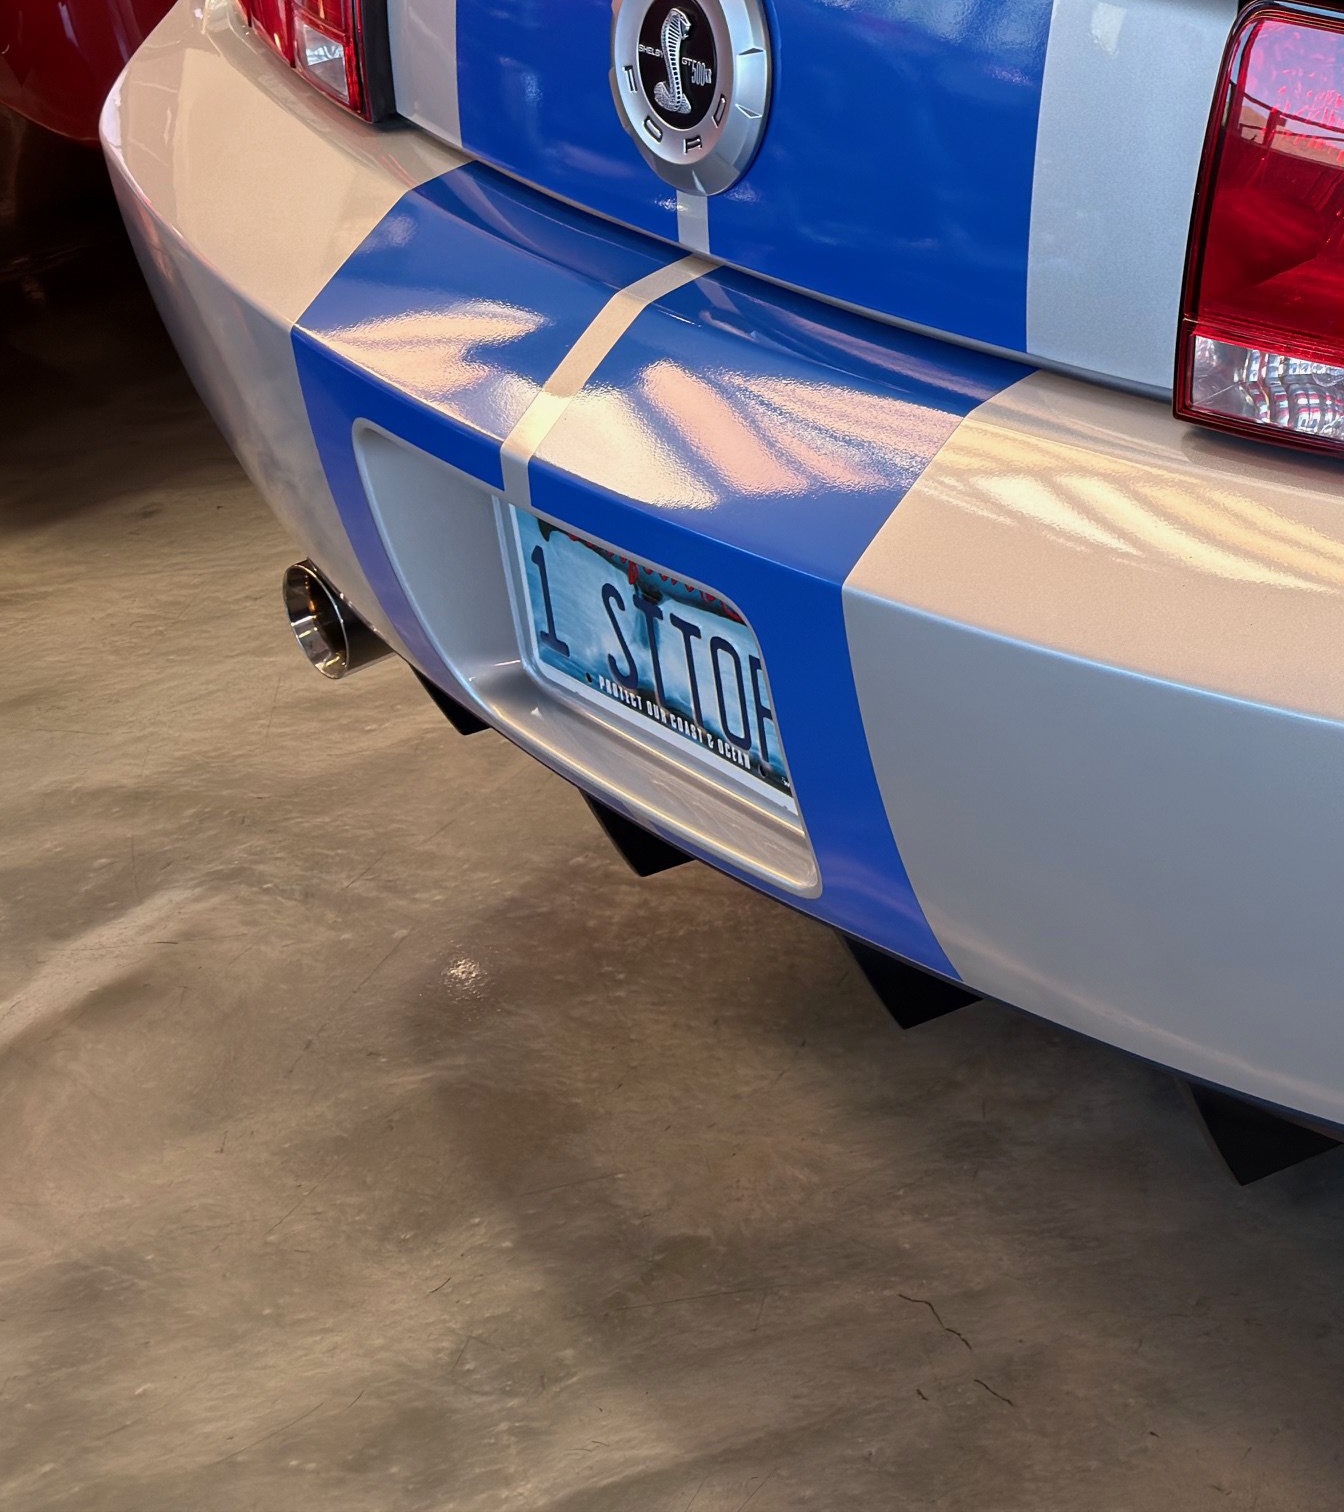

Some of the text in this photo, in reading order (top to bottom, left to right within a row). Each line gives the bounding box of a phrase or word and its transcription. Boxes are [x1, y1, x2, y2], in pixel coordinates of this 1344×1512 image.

[598, 674, 643, 711] PROTECT
[646, 700, 667, 725] OUR
[669, 713, 704, 744] COAST
[717, 738, 752, 770] OCEAN
